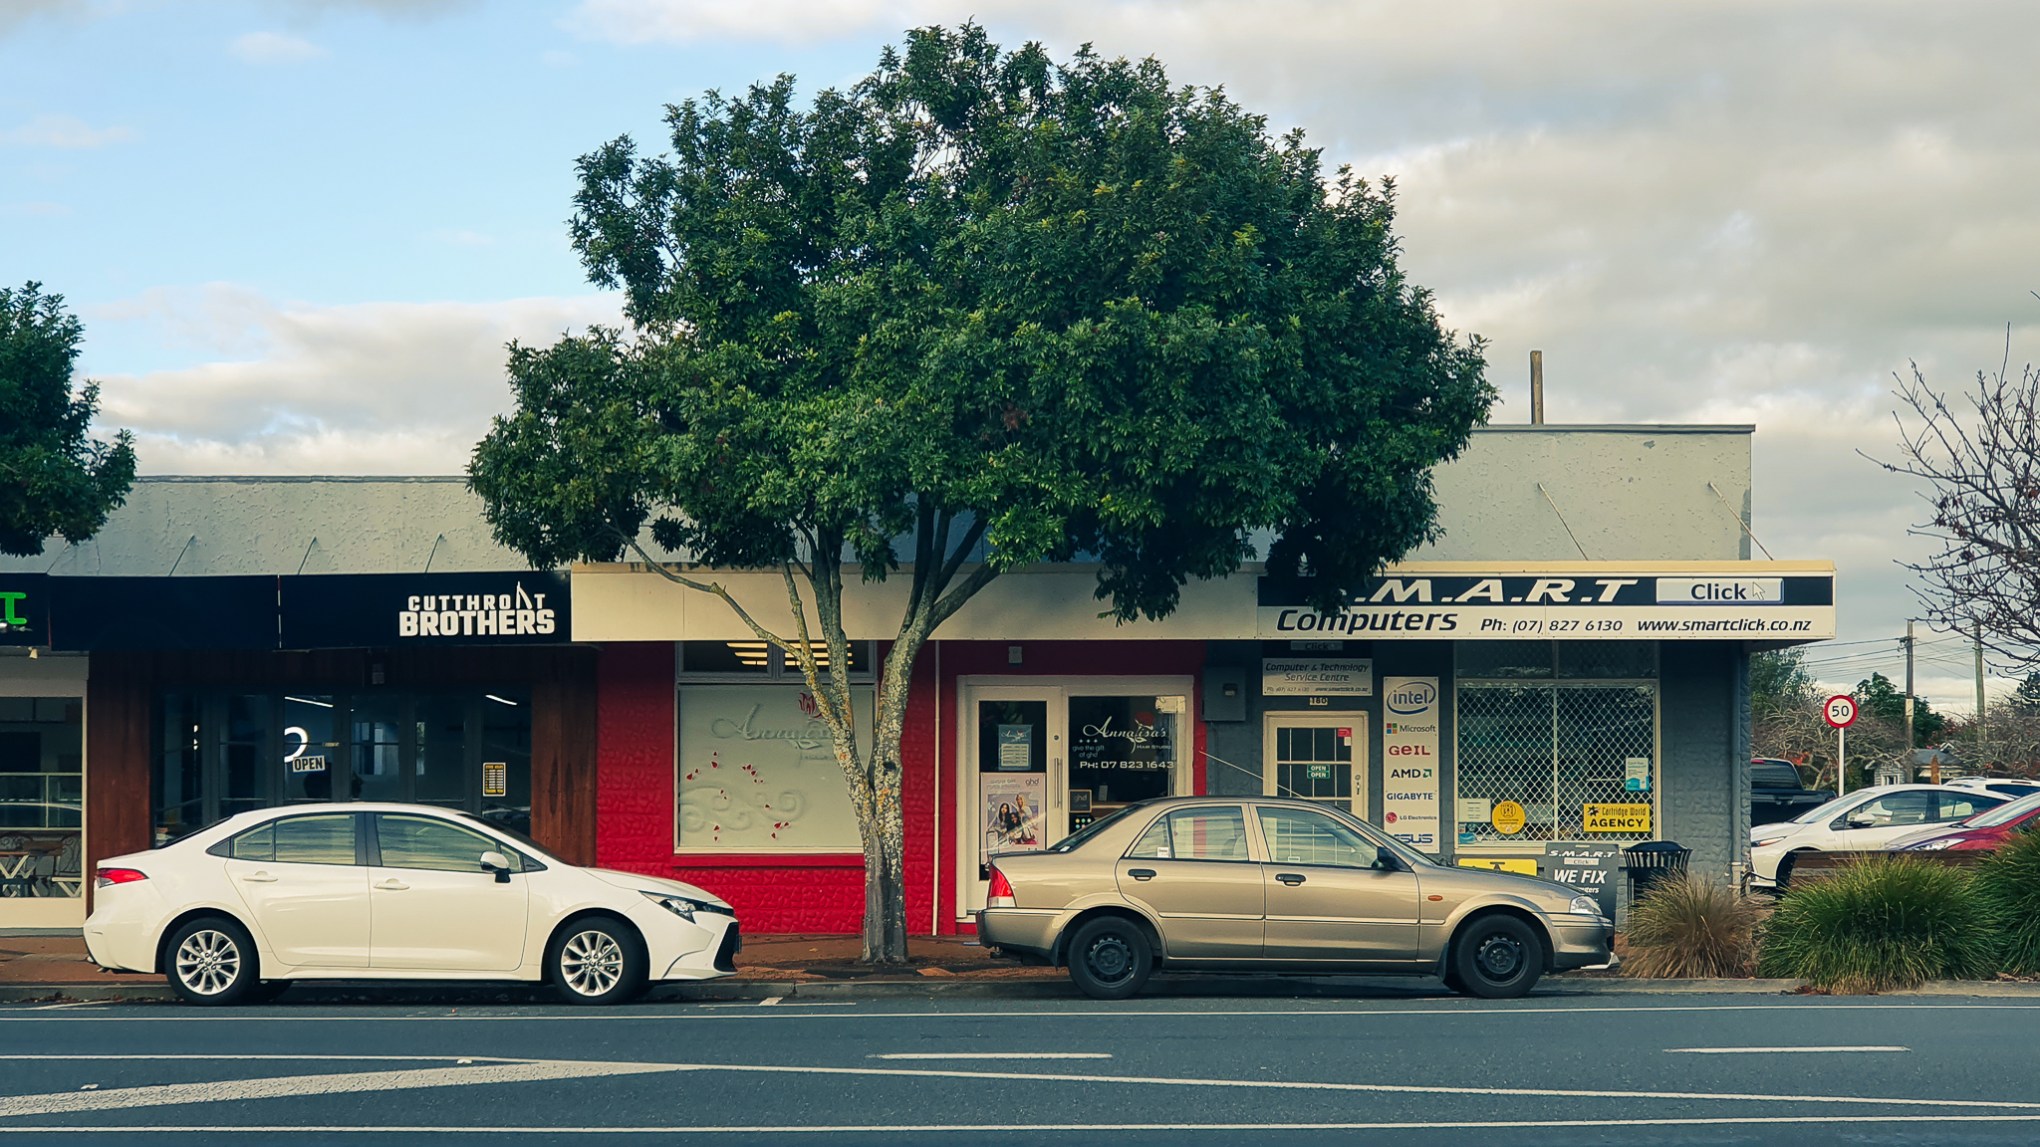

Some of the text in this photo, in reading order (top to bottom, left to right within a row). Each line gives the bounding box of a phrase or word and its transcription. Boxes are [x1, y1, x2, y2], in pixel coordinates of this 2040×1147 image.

[408, 581, 545, 611] CUTTHROAT
[1690, 583, 1747, 600] Click
[399, 609, 555, 637] BROTHERS
[1276, 609, 1458, 635] Computers
[1480, 618, 1812, 634] Ph: (07) 827 6130 www.smartclick.co.nz
[1265, 662, 1309, 673] Computer
[1320, 663, 1369, 673] Technology
[1285, 673, 1350, 682] Service Centre
[1393, 688, 1428, 705] intel
[1832, 705, 1849, 717] 50
[1399, 725, 1436, 733] Microsoft
[295, 757, 323, 771] OPEN
[1100, 761, 1117, 769] 07
[1119, 761, 1144, 769] 823
[1146, 761, 1174, 769] 1643
[1391, 769, 1421, 778] AMD
[1386, 793, 1433, 801] GIGABYTE
[1590, 818, 1644, 828] AGENCY
[1554, 868, 1608, 884] WE FIX
